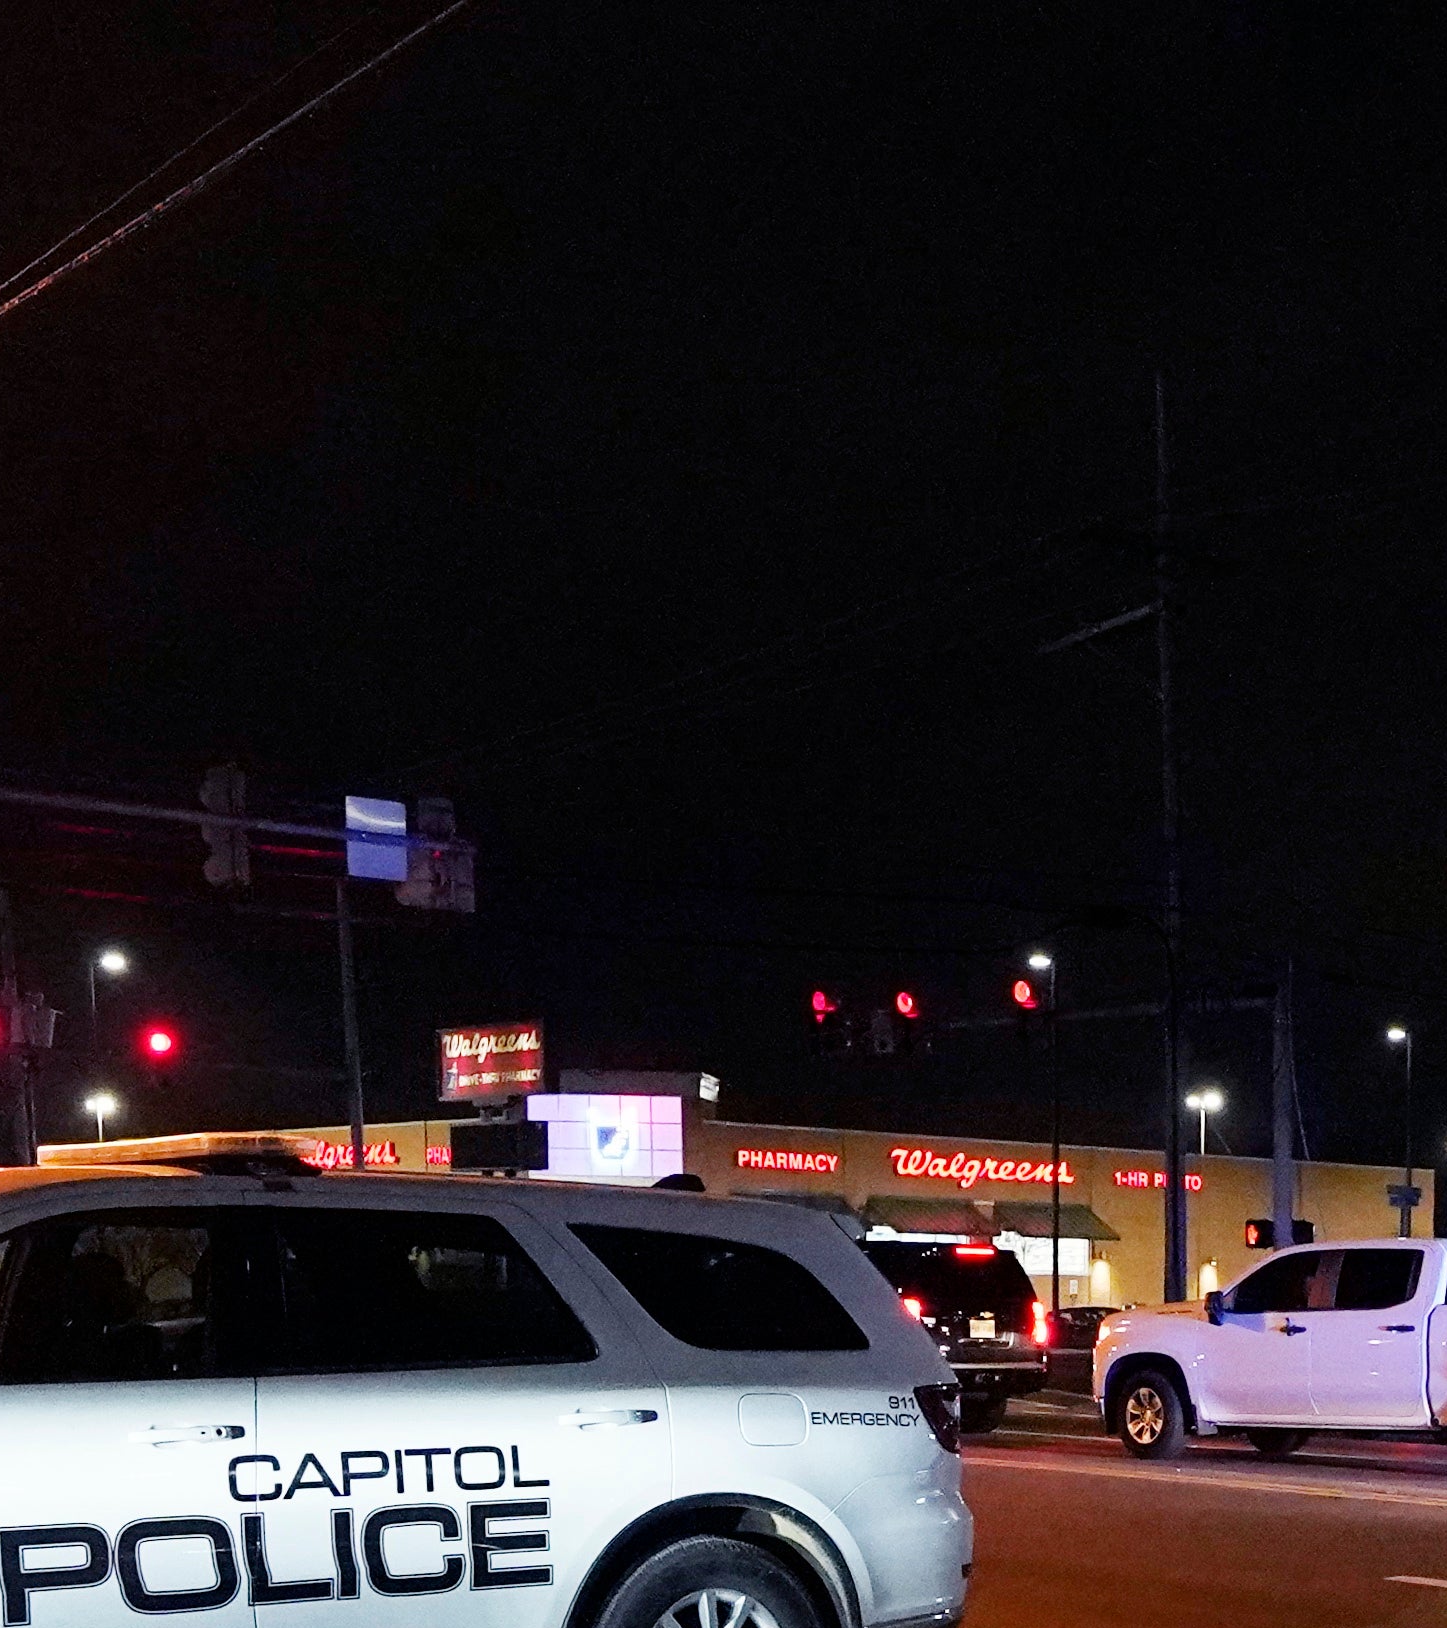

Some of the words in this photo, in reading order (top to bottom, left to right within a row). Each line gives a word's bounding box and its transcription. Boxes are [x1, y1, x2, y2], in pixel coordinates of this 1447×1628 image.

[442, 1030, 541, 1064] Walgreens
[737, 1149, 839, 1172] PHARMACY
[890, 1148, 1075, 1189] Walgreens
[1114, 1171, 1149, 1188] 1-HR
[1154, 1172, 1202, 1191] PTO
[888, 1396, 915, 1409] 911
[811, 1412, 920, 1427] EMERGENCY
[227, 1445, 550, 1502] CAPITOL
